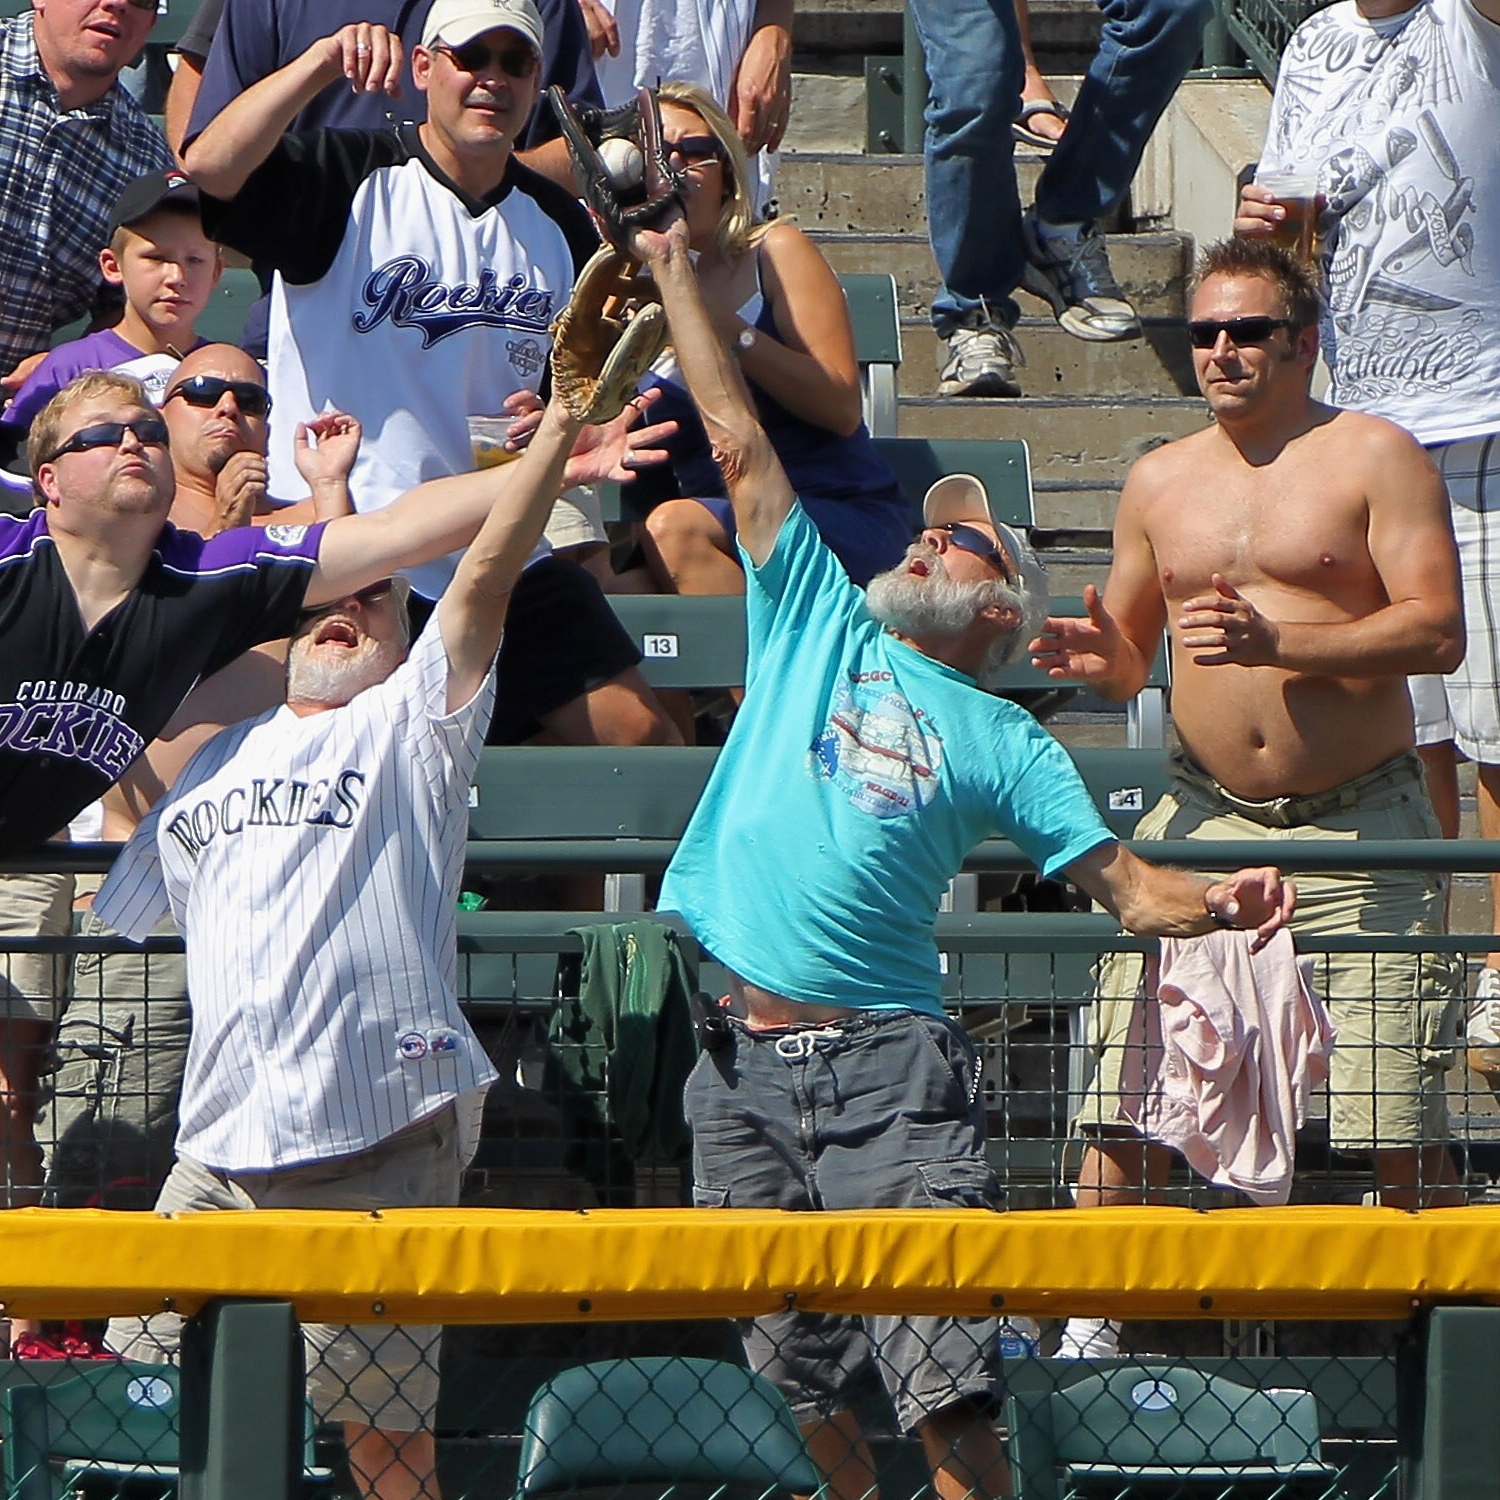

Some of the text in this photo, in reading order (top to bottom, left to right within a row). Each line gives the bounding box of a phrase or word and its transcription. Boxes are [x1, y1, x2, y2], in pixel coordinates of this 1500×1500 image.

[351, 254, 556, 333] Rockies
[650, 638, 671, 654] 13
[16, 680, 127, 716] COLORADO
[166, 769, 366, 865] ROCKIES
